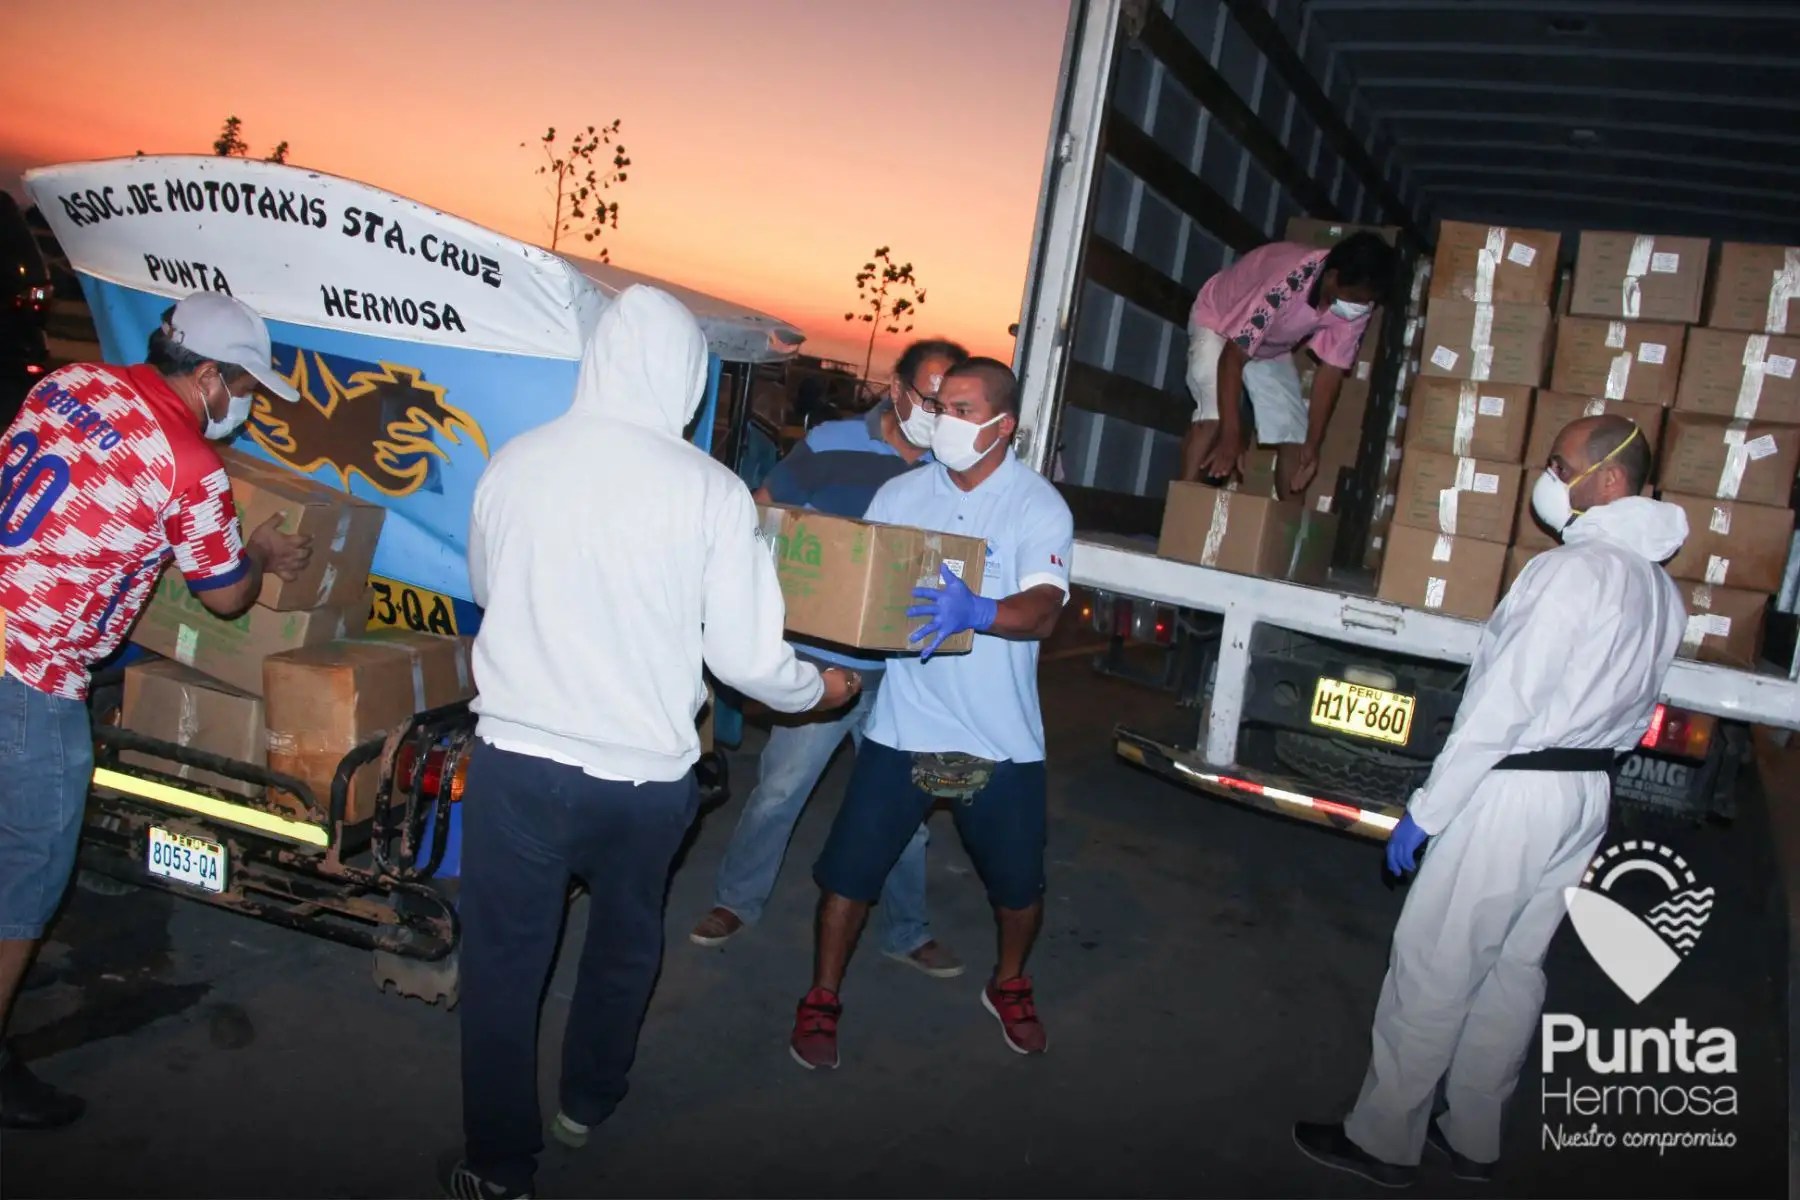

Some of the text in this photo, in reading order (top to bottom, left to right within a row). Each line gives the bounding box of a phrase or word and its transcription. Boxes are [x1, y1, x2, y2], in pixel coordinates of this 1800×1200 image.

[165, 178, 328, 229] MOTOTAXIS
[144, 252, 467, 333] PUNTA HERMOSA
[36, 381, 123, 451] ROBERTO
[1316, 689, 1406, 735] H1Y-860
[1348, 685, 1383, 701] PERU
[1621, 753, 1688, 788] DMG
[153, 841, 217, 881] 8053-QA
